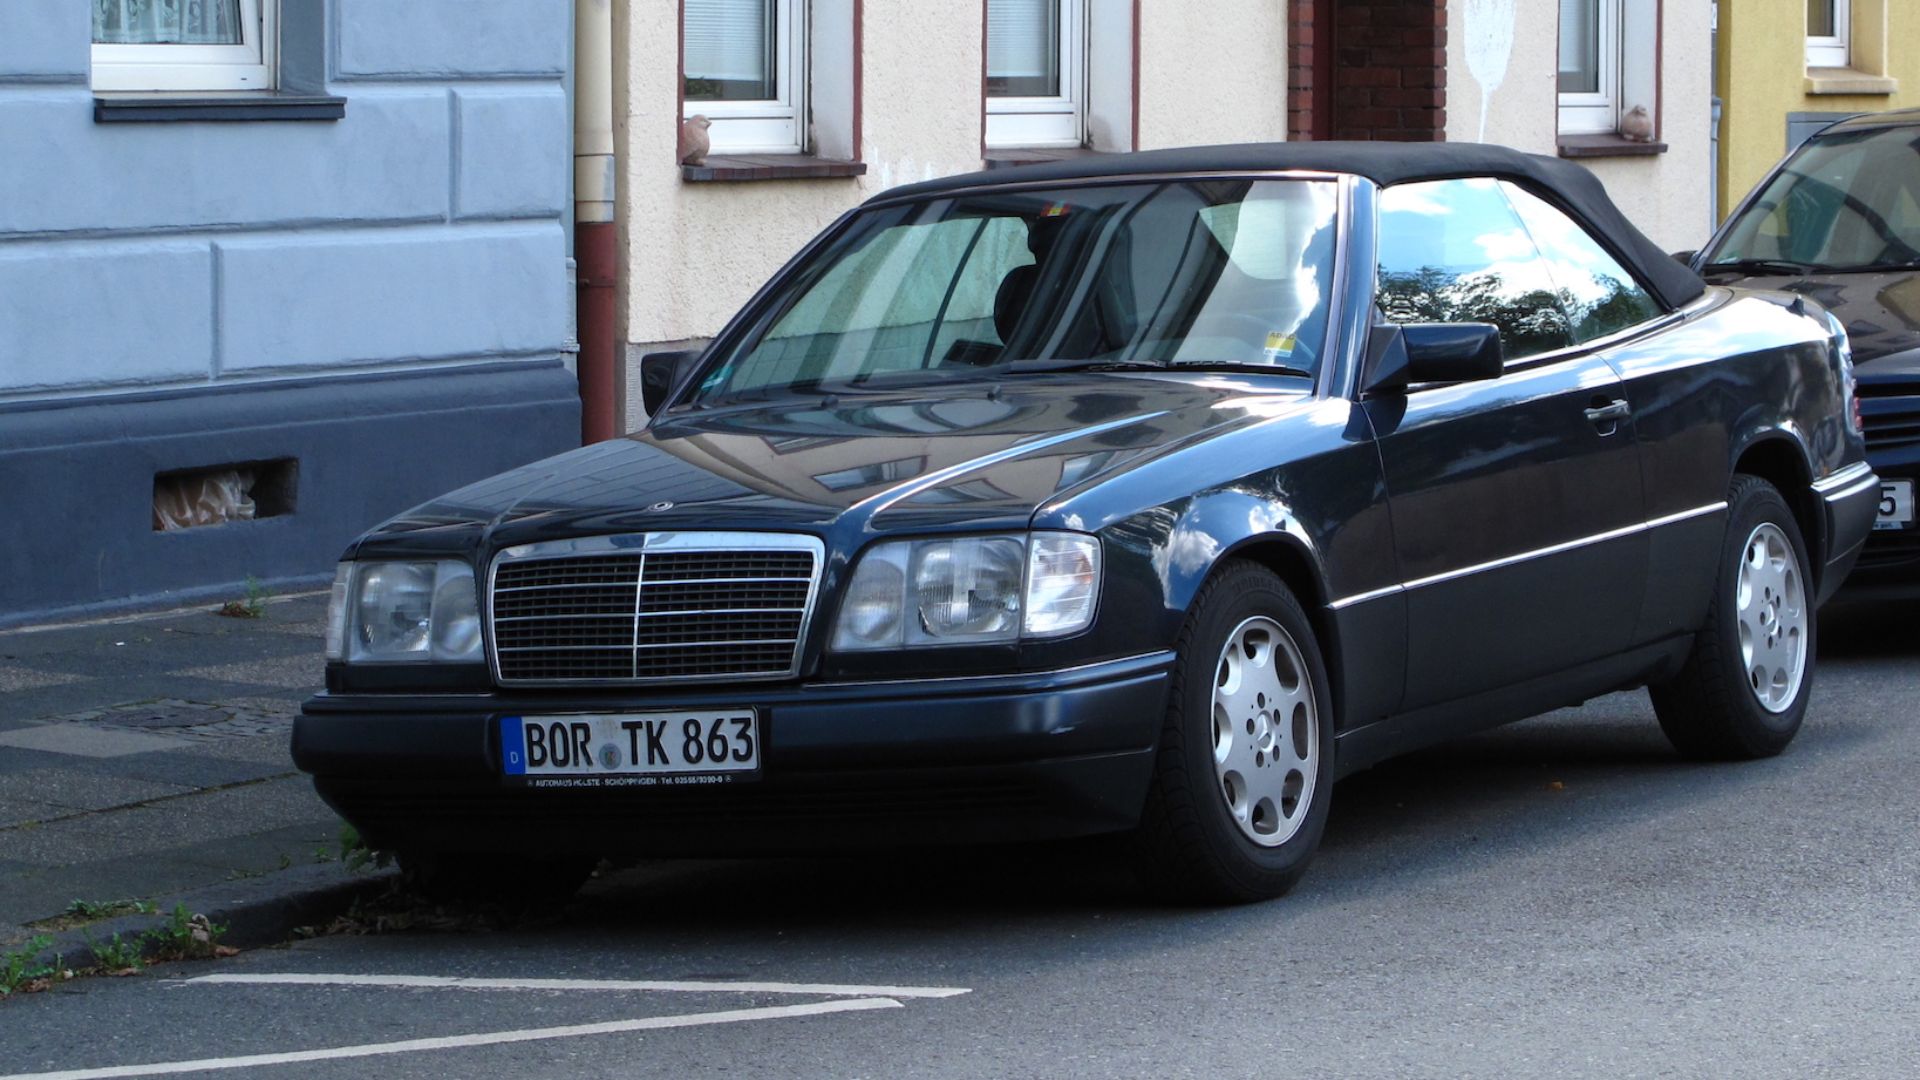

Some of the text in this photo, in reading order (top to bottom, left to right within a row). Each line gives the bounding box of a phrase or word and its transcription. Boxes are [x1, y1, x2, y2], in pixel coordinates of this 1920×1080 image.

[1879, 486, 1896, 516] 5
[525, 717, 754, 768] BOR TK 863
[510, 751, 519, 764] D
[535, 778, 573, 788] AUTOHAUS
